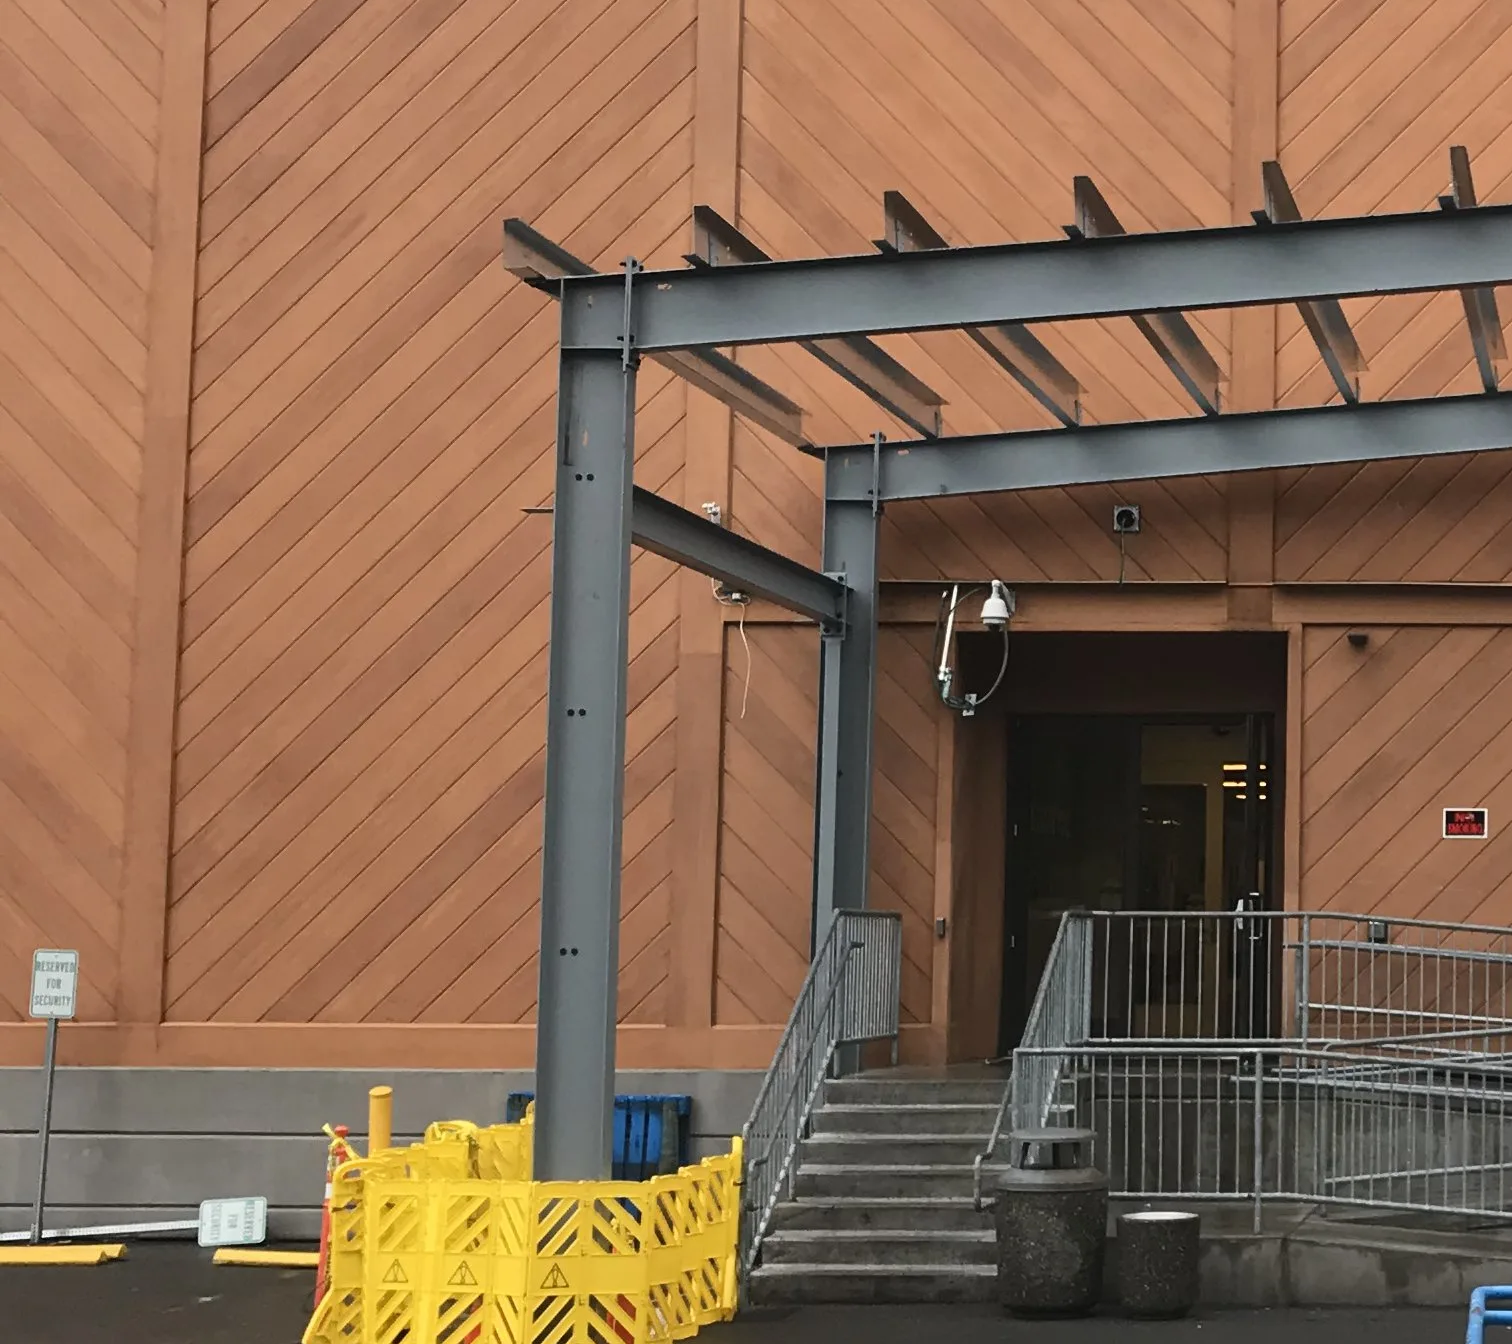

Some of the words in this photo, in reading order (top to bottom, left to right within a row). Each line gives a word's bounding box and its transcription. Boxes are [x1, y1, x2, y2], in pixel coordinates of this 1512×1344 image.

[35, 961, 76, 973] RESERVED
[46, 978, 62, 989] FOR
[33, 995, 71, 1006] SECURITY
